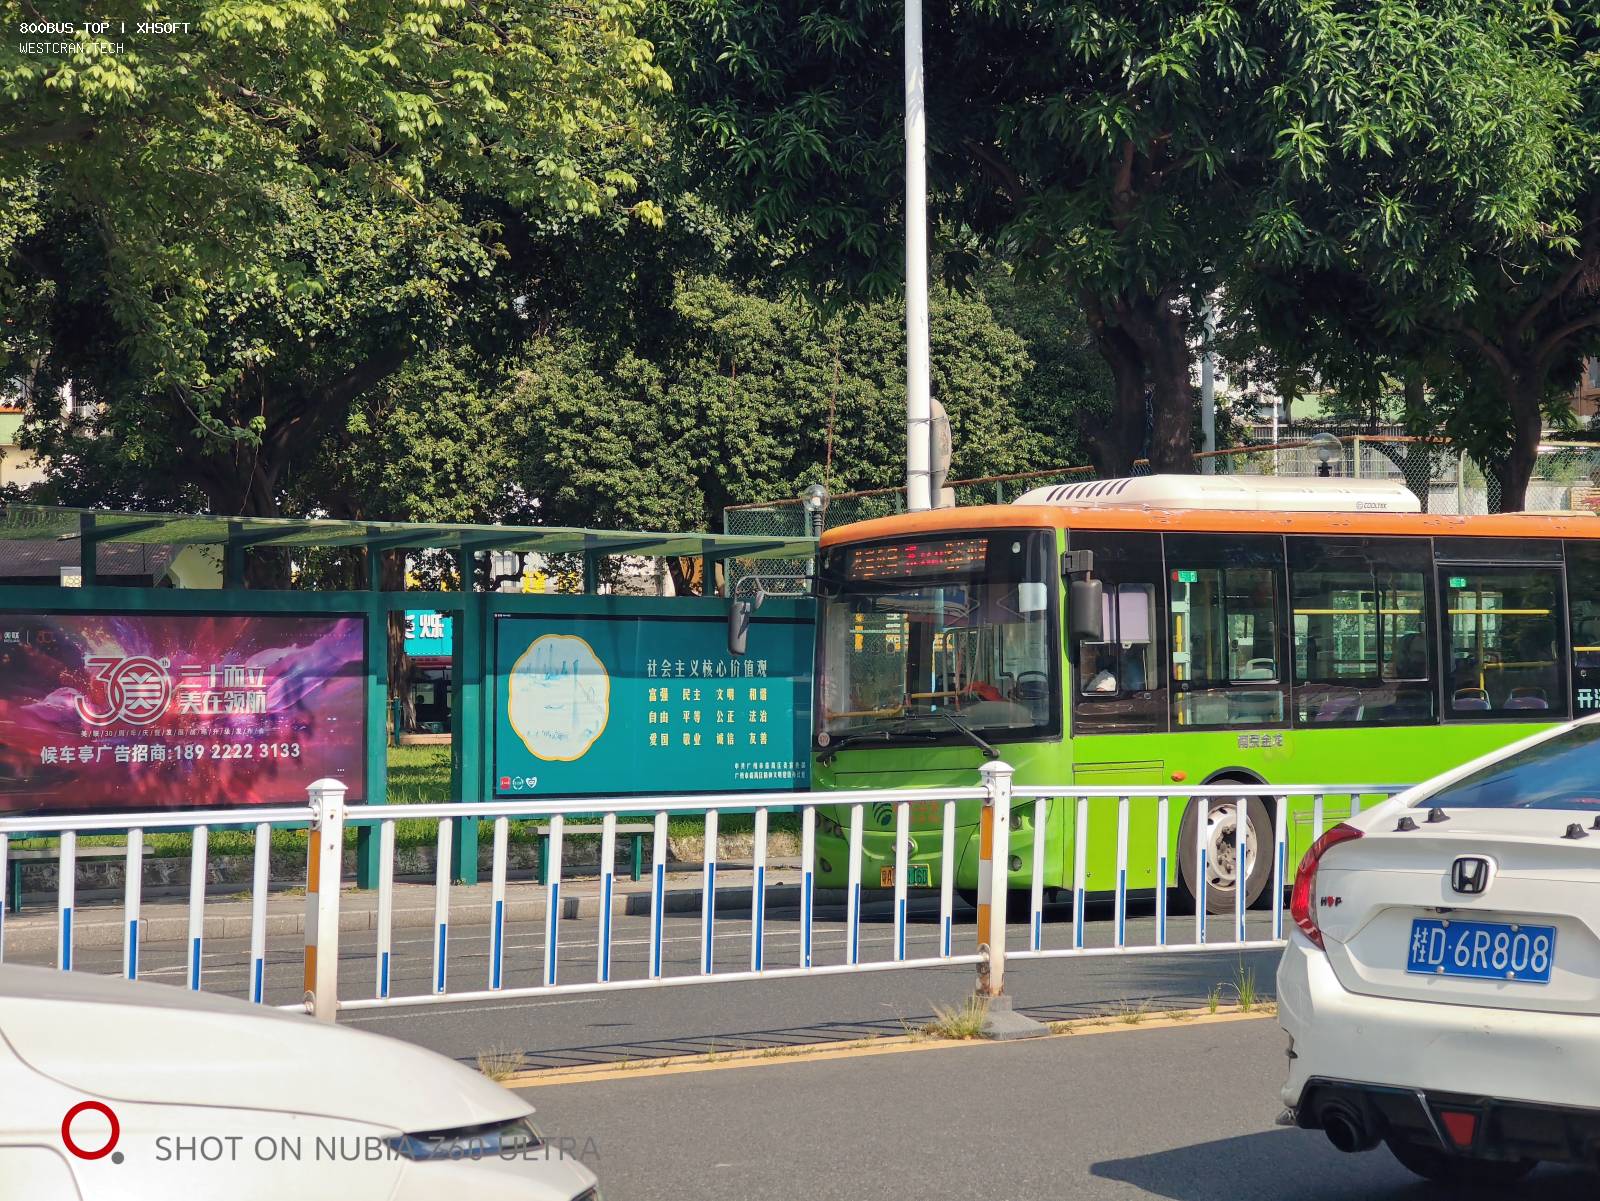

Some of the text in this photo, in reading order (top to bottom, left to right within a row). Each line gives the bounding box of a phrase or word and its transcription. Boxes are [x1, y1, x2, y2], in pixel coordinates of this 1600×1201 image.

[179, 664, 268, 689] 三十而立
[647, 659, 768, 678] 社会主义核心价值观
[179, 691, 268, 714] 美在领航
[648, 688, 768, 702] 富强 民主 文明 和谐
[648, 710, 768, 724] 自由 平等 公正 法治
[649, 732, 768, 746] 爱国 敬业 诚信 友善
[211, 744, 253, 759] 2222
[259, 743, 300, 757] 3133
